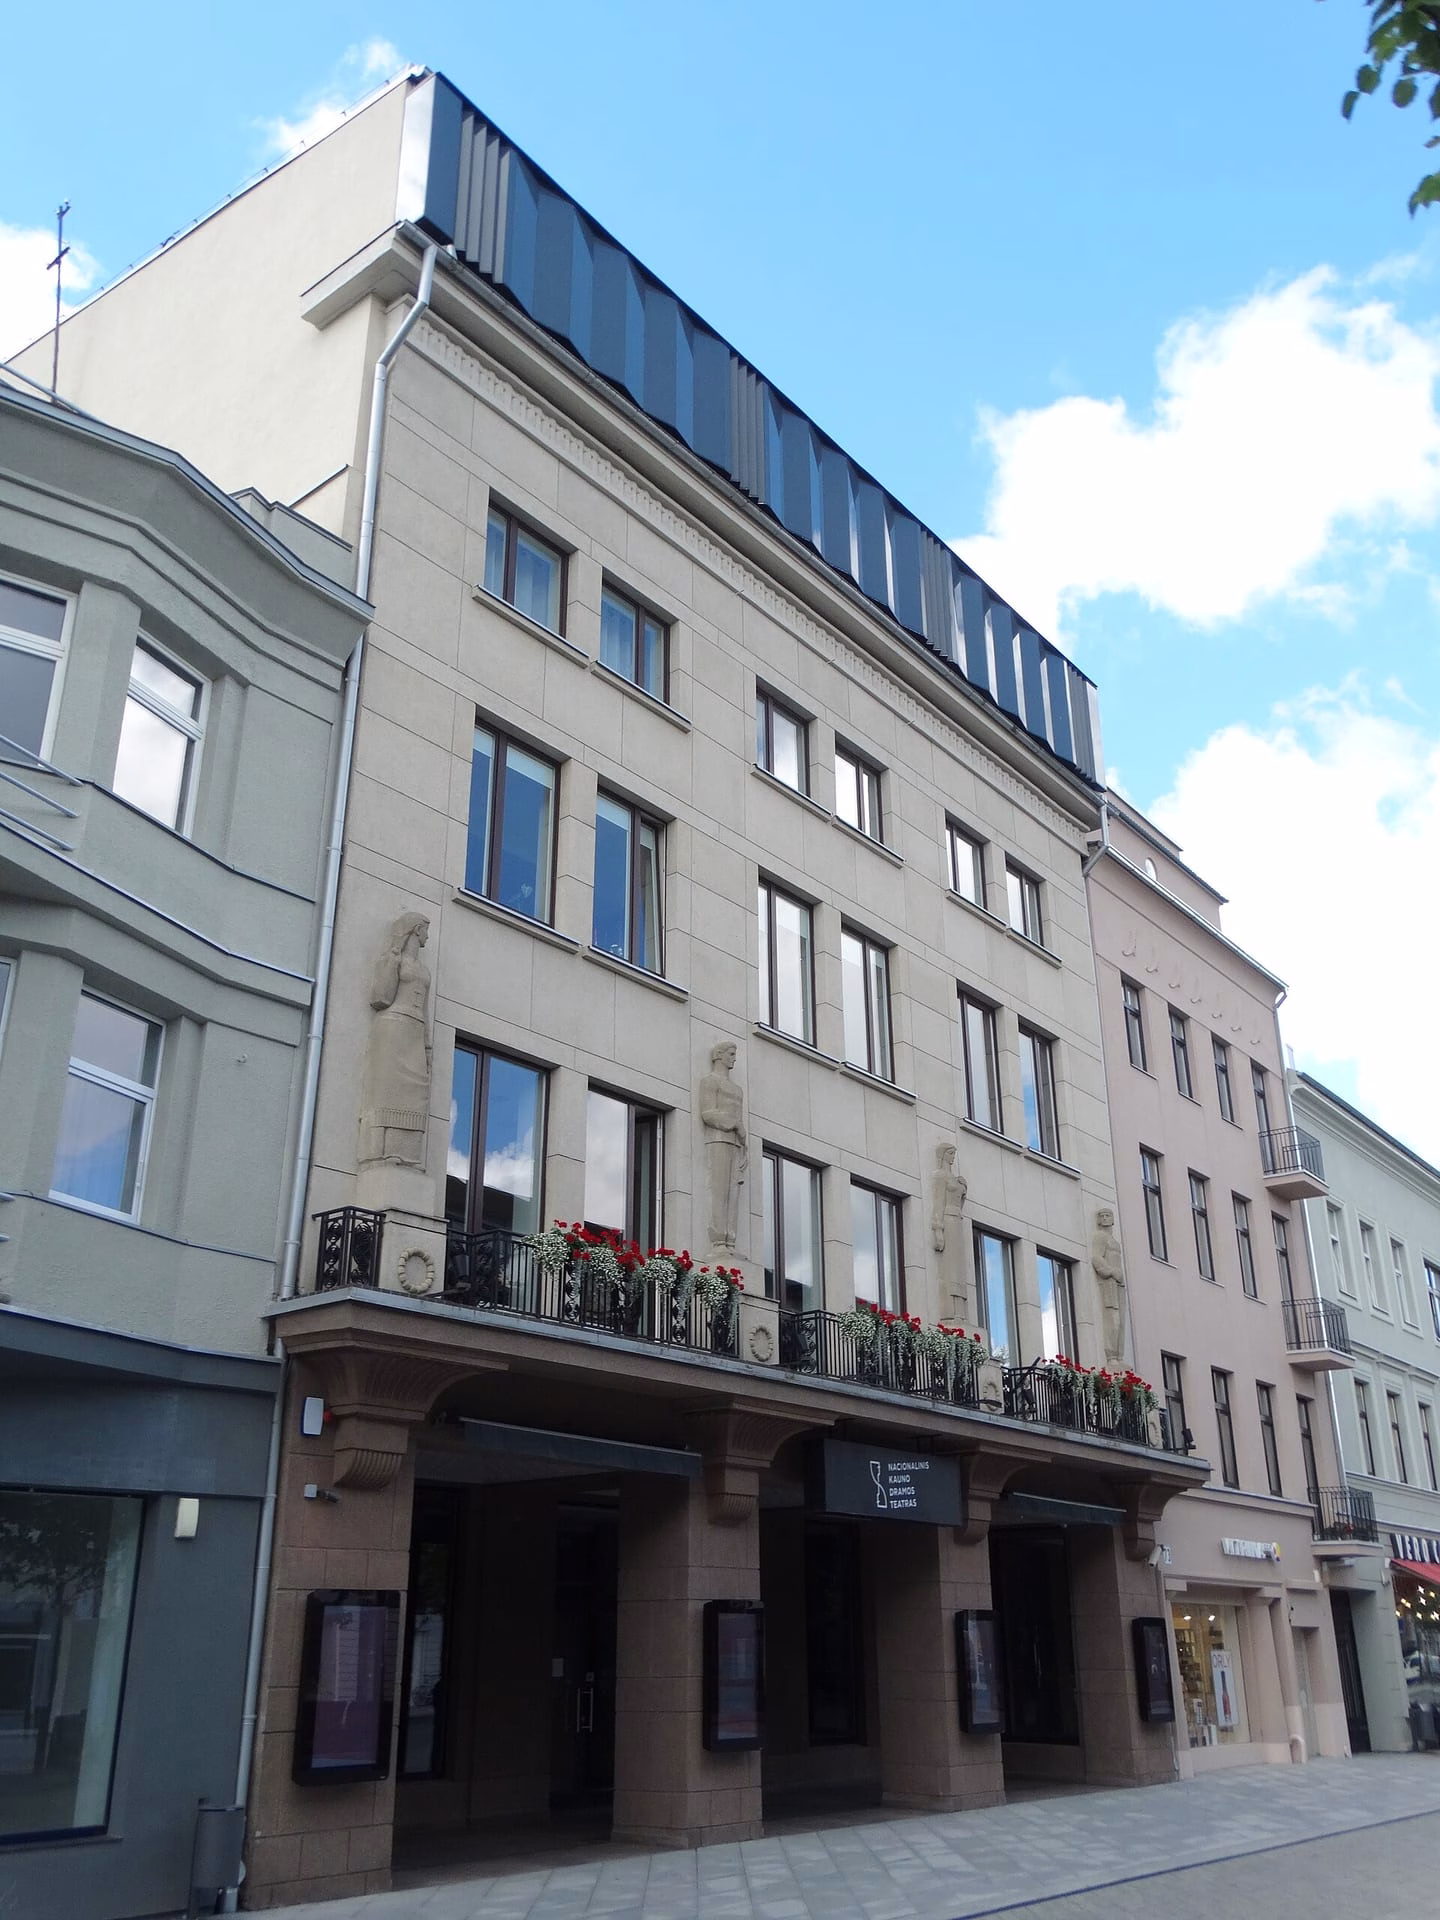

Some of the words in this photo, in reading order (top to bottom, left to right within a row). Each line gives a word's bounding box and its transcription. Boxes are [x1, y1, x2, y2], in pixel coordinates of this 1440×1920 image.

[888, 1461, 929, 1471] NACIONALINIS
[888, 1474, 910, 1484] KAUNO
[889, 1486, 915, 1496] DRAMOS
[890, 1499, 917, 1508] TEATRAS
[1395, 1533, 1430, 1562] VERO
[1212, 1653, 1231, 1669] ORLY
